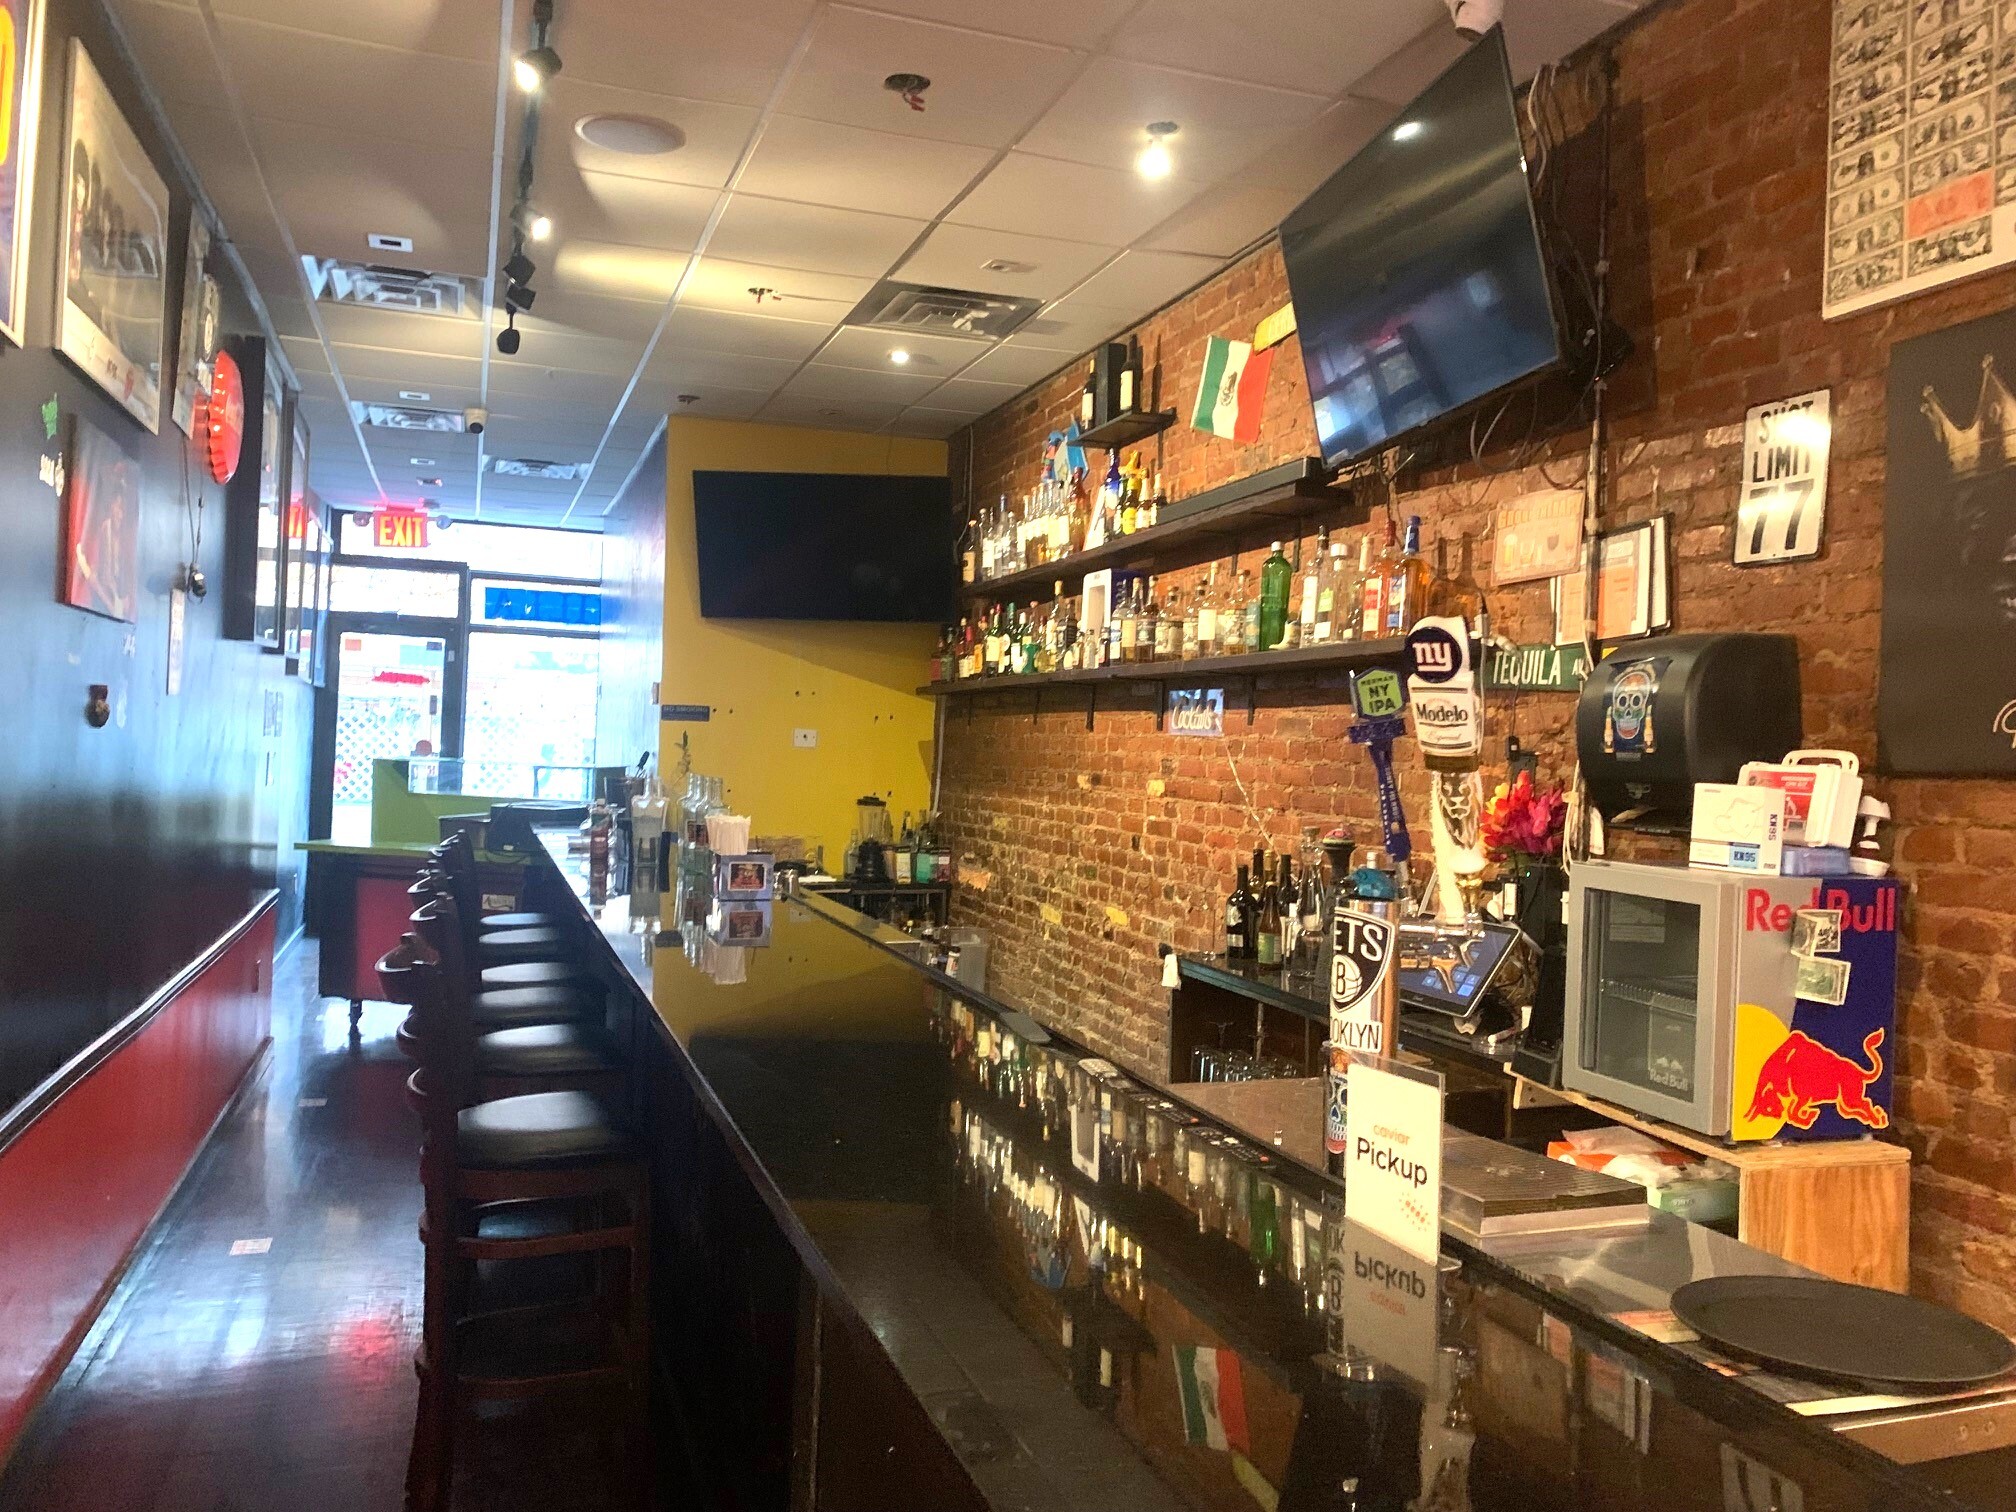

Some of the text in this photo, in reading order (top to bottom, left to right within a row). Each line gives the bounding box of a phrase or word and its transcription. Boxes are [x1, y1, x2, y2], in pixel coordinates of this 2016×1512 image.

[1759, 400, 1814, 445] ST
[379, 515, 423, 546] EXIT
[1749, 478, 1815, 555] 77
[1412, 642, 1452, 672] ny
[1493, 650, 1561, 686] TEQUILA
[1368, 683, 1390, 699] NY
[1368, 697, 1396, 714] IPA
[1415, 702, 1469, 722] Modelo
[1768, 813, 1778, 841] KN95
[1733, 850, 1756, 863] KN95
[1826, 887, 1896, 933] Bull
[1331, 1016, 1380, 1050] OKLYN
[1650, 1068, 1689, 1091] Red Bull
[1373, 1124, 1411, 1146] caviar
[1357, 1136, 1428, 1189] Pickup
